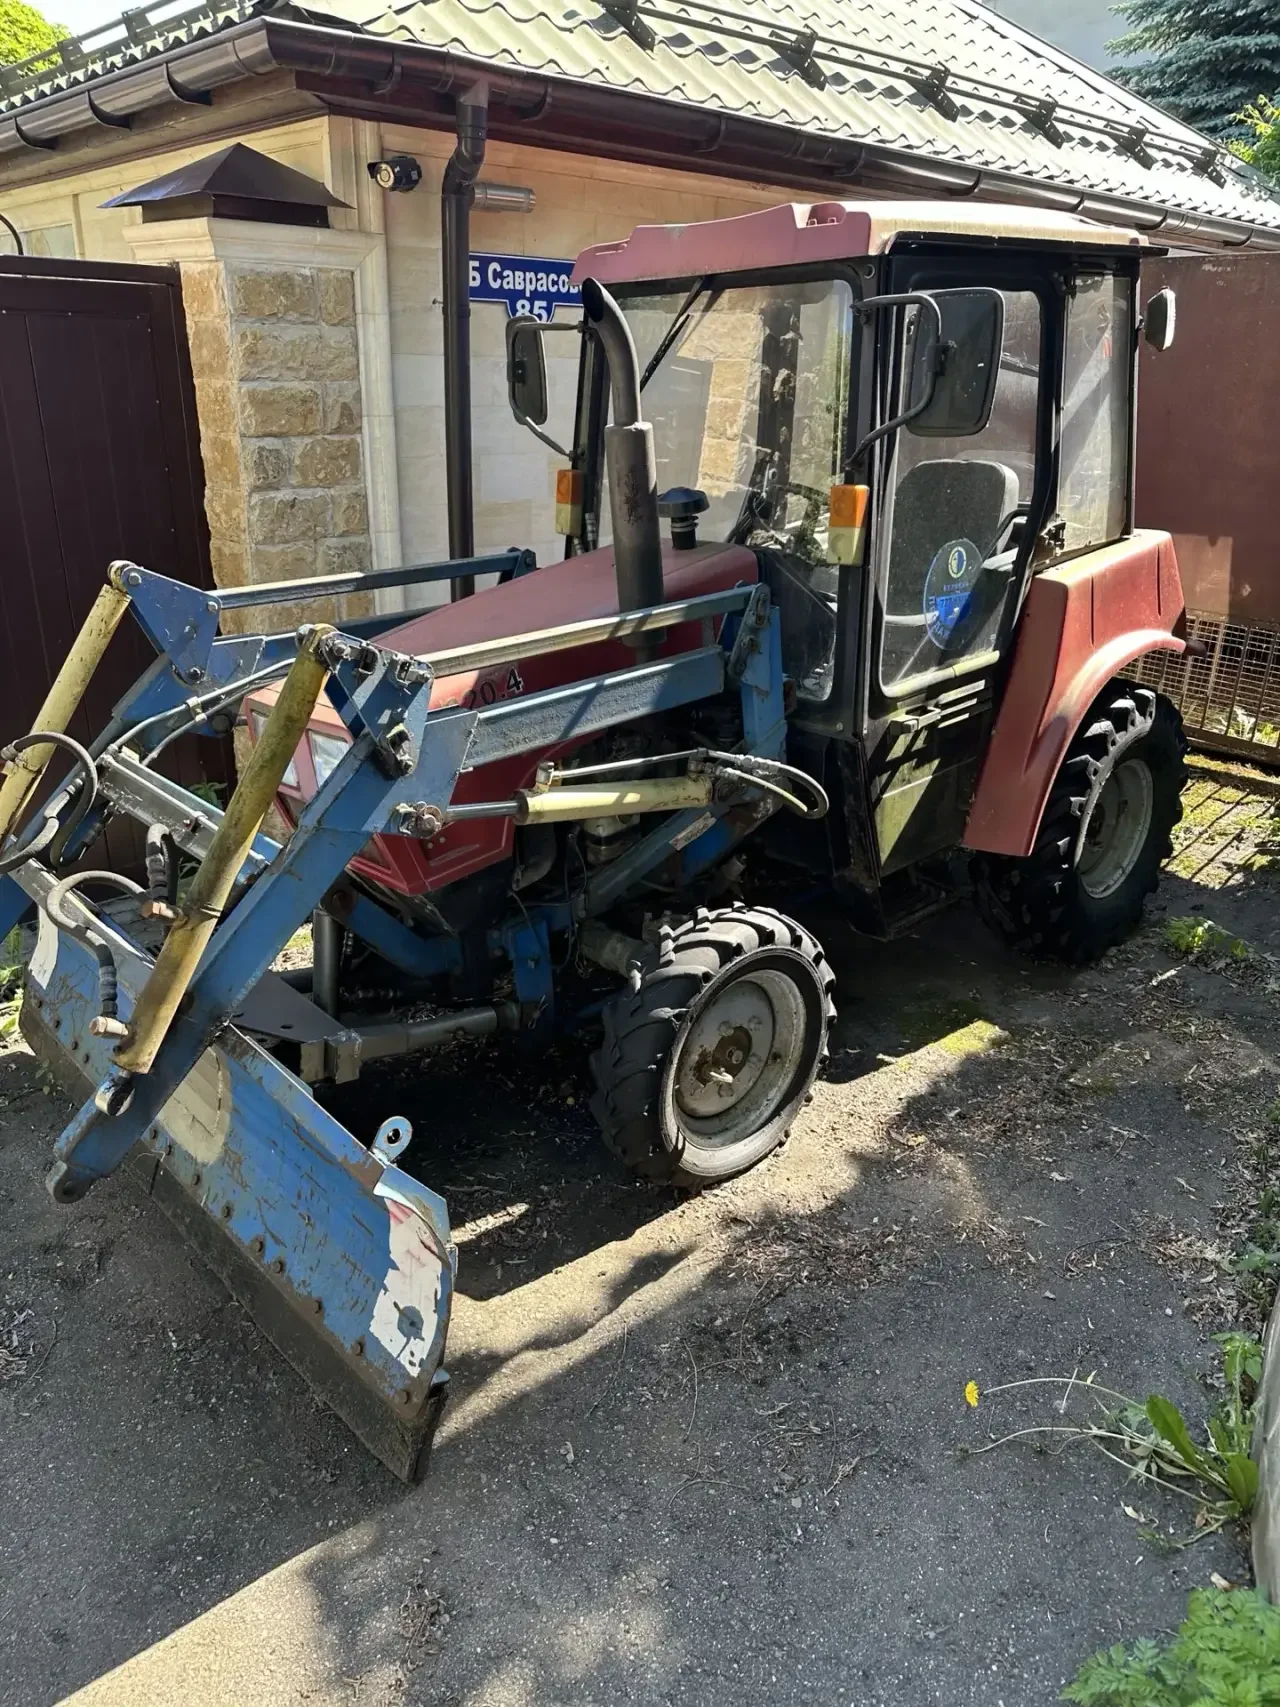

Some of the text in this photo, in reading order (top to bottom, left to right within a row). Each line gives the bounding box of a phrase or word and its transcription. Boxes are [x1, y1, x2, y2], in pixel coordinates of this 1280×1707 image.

[469, 260, 582, 297] Б Саврасо
[515, 299, 548, 323] 85
